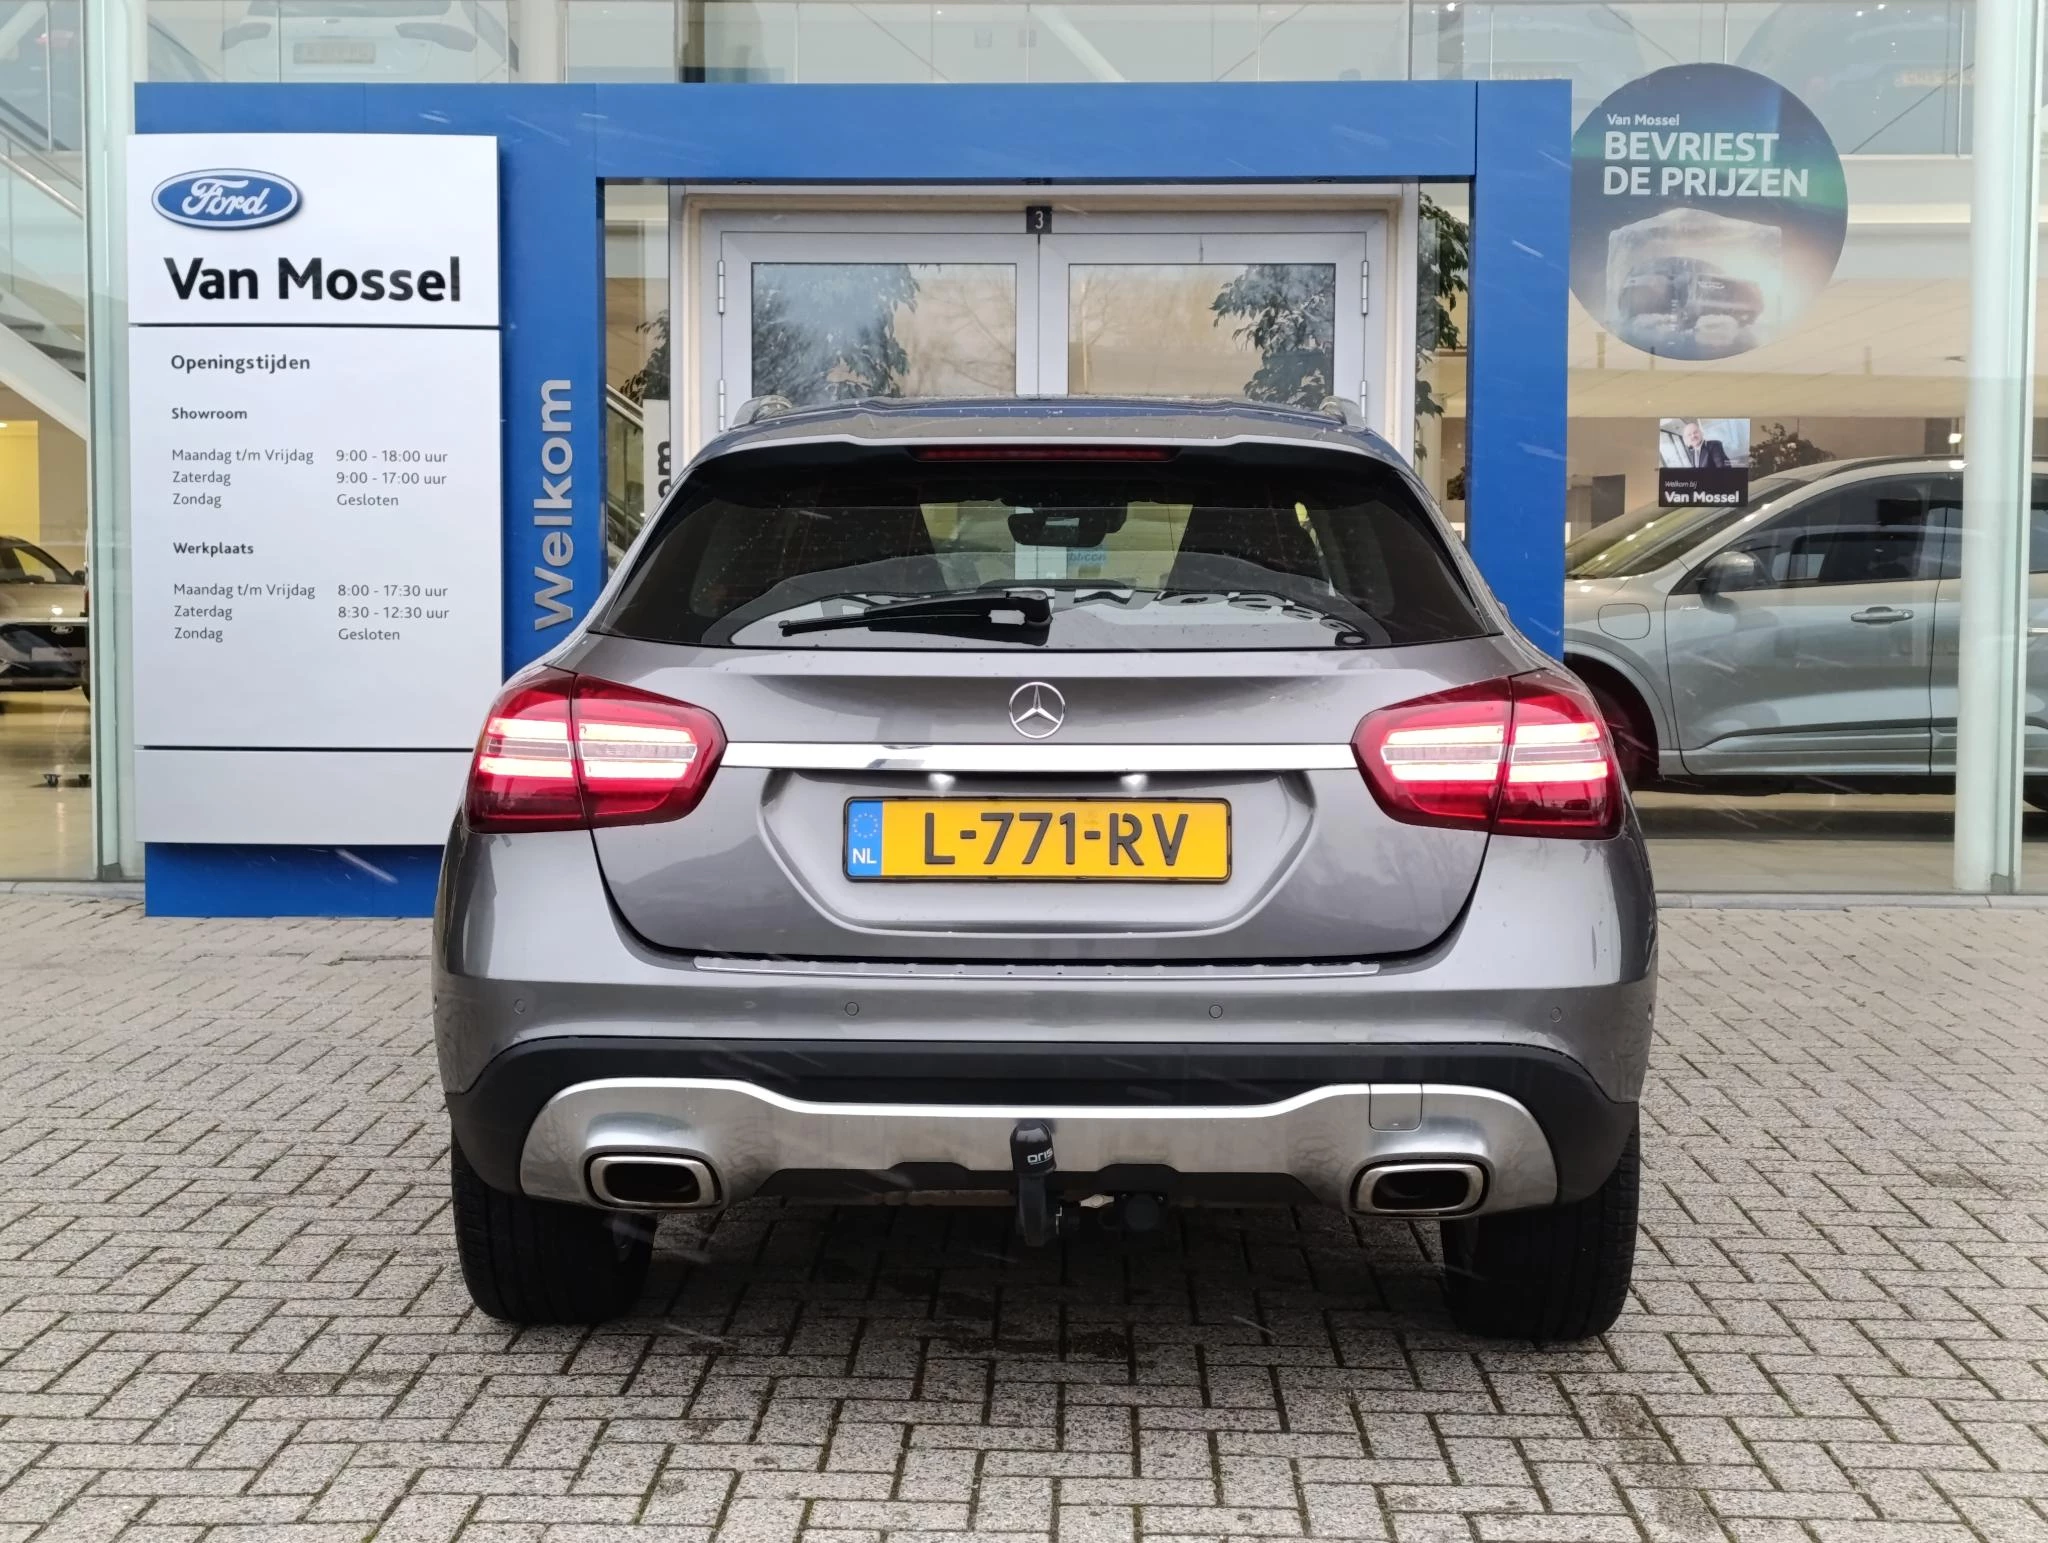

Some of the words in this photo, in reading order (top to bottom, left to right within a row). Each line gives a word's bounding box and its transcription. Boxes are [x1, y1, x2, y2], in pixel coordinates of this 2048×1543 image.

[1607, 114, 1630, 125] Van
[1635, 114, 1679, 126] Mossel
[1605, 131, 1779, 161] BEVRIEST
[1604, 166, 1651, 195] DE
[1661, 167, 1808, 197] PRIJZEN
[182, 178, 270, 216] Ford
[1035, 211, 1043, 229] 3
[164, 258, 258, 300] Van
[278, 257, 460, 301] Mossel
[171, 354, 310, 374] Openingstijden
[172, 407, 247, 419] Showroom
[172, 449, 231, 464] Maandag
[236, 448, 260, 461] t/m
[265, 449, 313, 464] Vrijdag
[336, 450, 367, 461] 9:00
[382, 450, 420, 462] 18:00
[425, 454, 447, 462] uur
[173, 471, 231, 486] Zaterdag
[337, 472, 367, 483] 9:00
[382, 472, 419, 484] 17:00
[424, 476, 447, 484] uur
[173, 493, 221, 508] Zondag
[337, 494, 398, 506] Gesloten
[534, 379, 573, 631] Welkom
[1665, 491, 1690, 503] Van
[1693, 491, 1739, 503] Mossel
[173, 542, 253, 557] Werkplaats
[174, 584, 233, 599] Maandag
[238, 584, 262, 596] t/m
[266, 584, 315, 599] Vrijdag
[338, 584, 369, 596] 8:00
[384, 585, 420, 596] 17:30
[425, 588, 448, 596] uur
[174, 605, 232, 621] Zaterdag
[338, 607, 369, 618] 8:30
[384, 607, 422, 618] 12:30
[427, 610, 449, 618] uur
[175, 627, 223, 643] Zondag
[339, 628, 400, 640] Gesloten
[924, 812, 1189, 866] L-771-RV
[852, 848, 877, 864] NL
